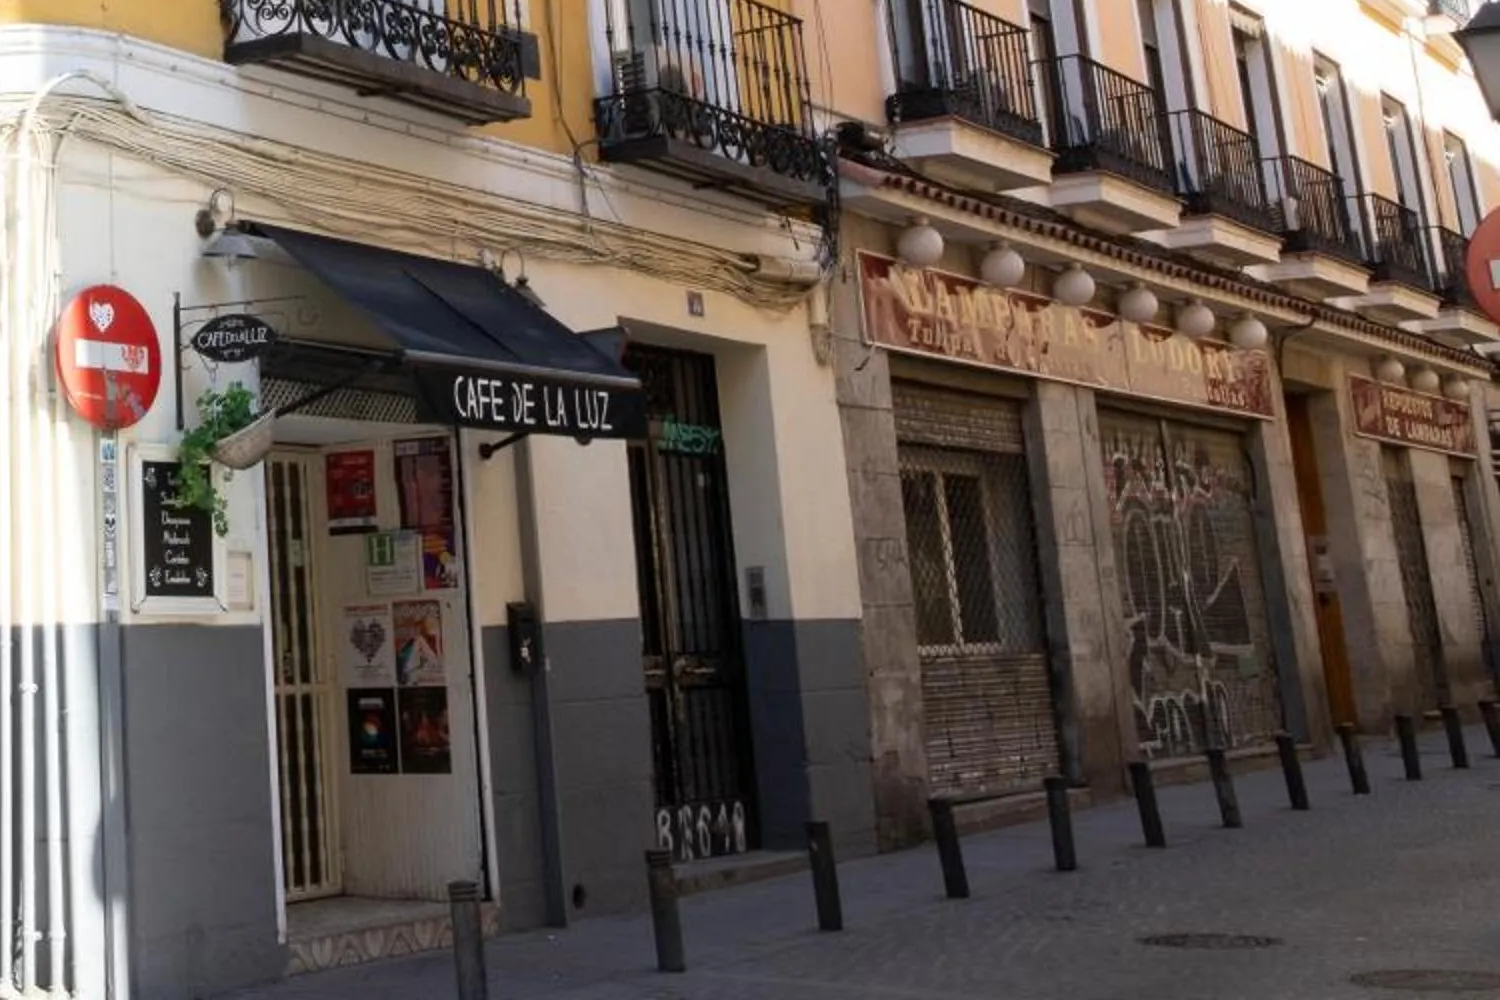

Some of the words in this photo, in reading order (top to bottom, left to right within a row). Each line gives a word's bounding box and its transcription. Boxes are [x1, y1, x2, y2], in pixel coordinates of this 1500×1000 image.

[453, 375, 506, 422] CAFE
[512, 382, 536, 425] DE
[543, 386, 569, 427] LA
[575, 389, 613, 431] LUZ
